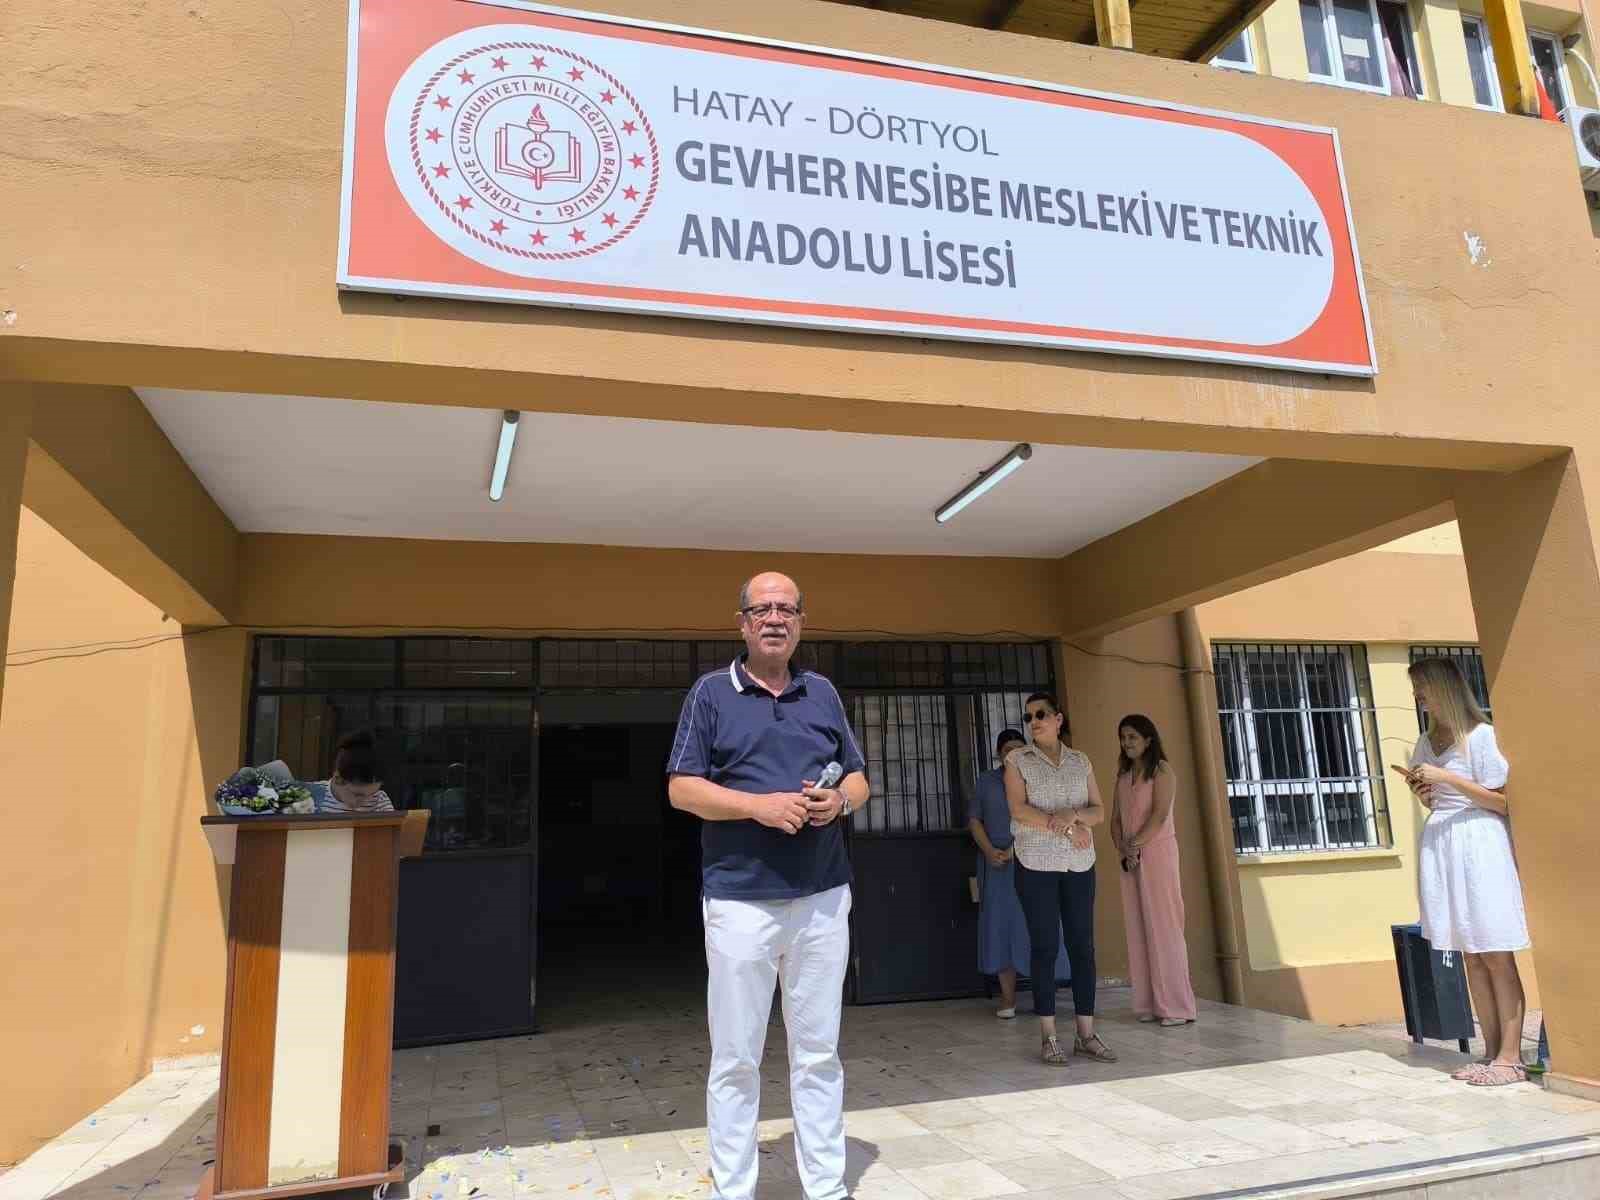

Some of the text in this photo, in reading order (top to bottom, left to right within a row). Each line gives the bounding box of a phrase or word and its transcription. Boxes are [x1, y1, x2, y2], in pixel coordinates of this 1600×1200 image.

[673, 85, 793, 127] HATAY
[829, 106, 999, 156] DÖRTYOL
[557, 158, 615, 218] BAKANLIĞI
[675, 140, 1324, 257] GEVHER NESİBE MESLEKİ VE TEKNİK
[678, 213, 1017, 289] ANADOLU LİSESİ
